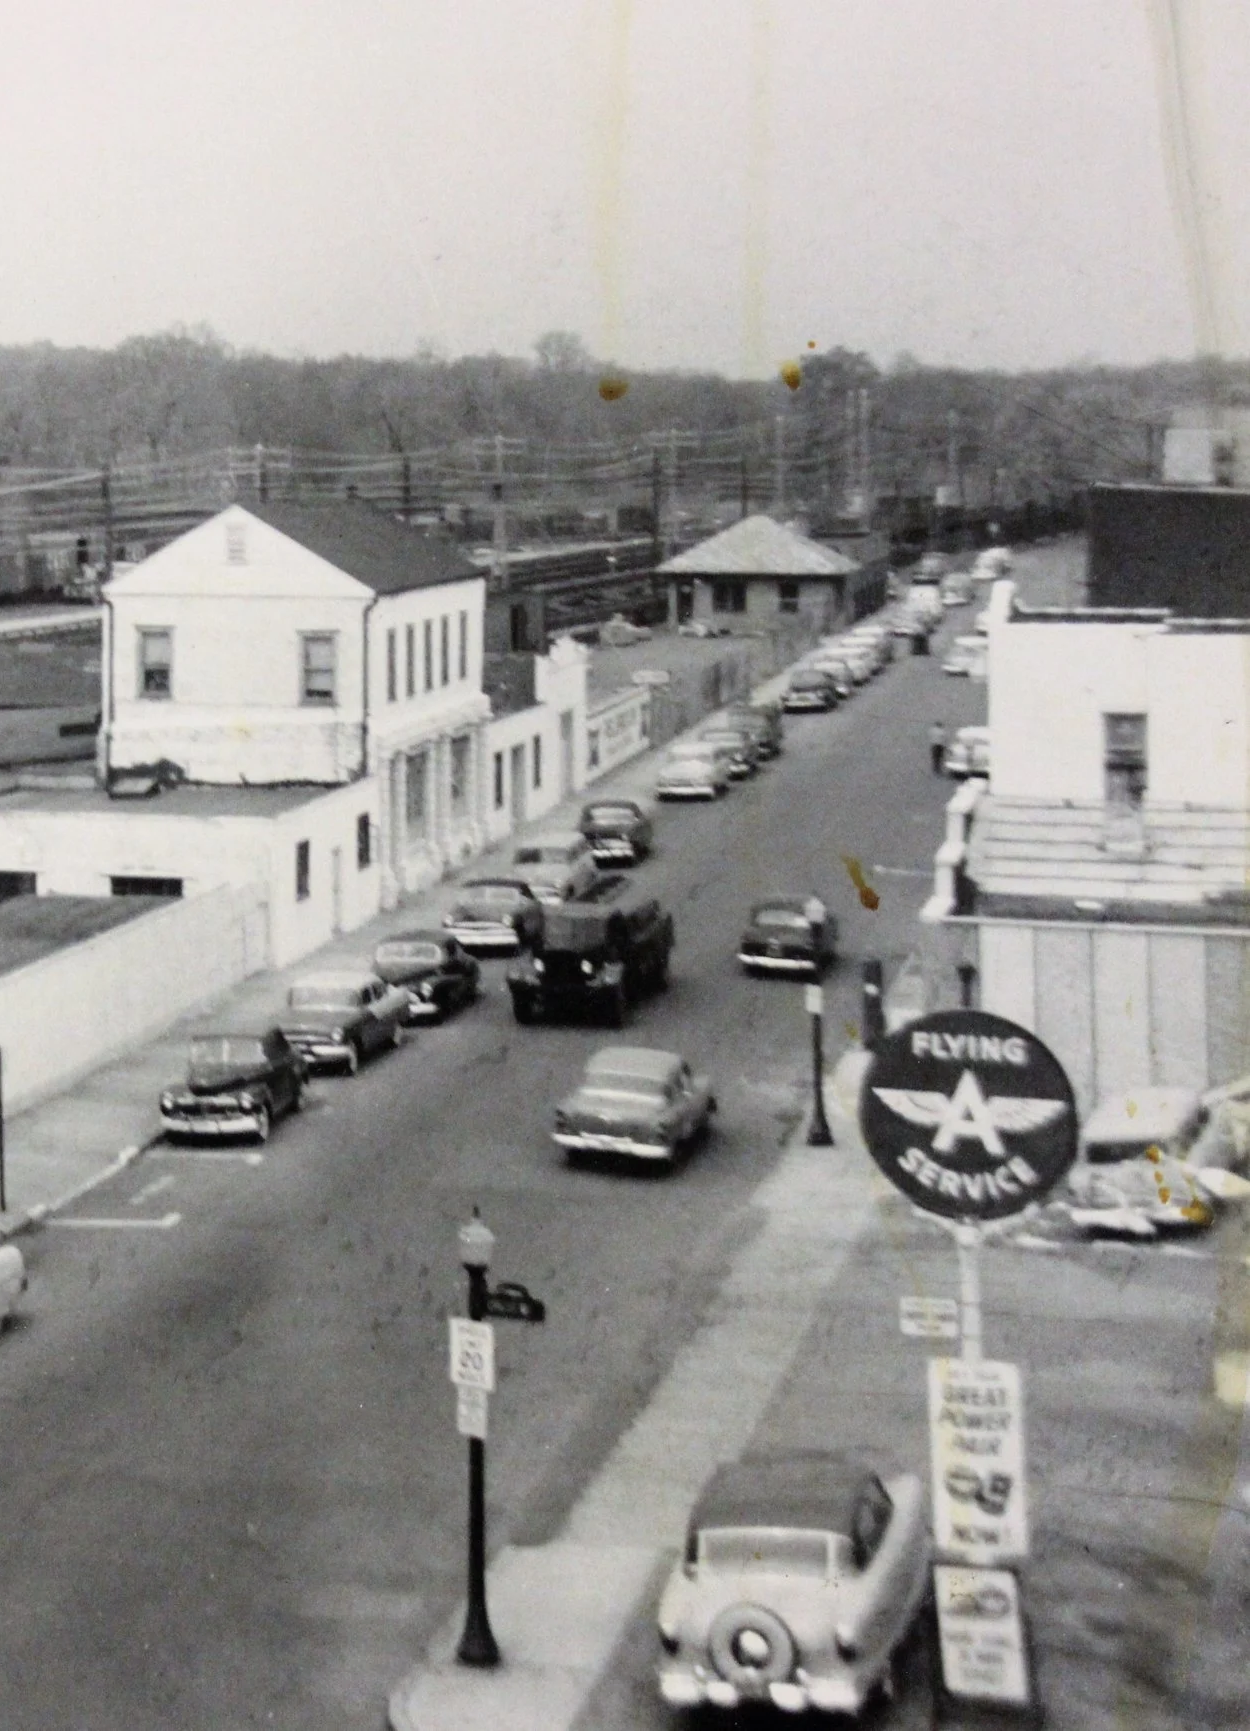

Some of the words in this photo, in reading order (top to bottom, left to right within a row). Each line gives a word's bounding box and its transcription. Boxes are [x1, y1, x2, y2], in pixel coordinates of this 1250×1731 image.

[911, 1031, 1030, 1065] FLYING
[897, 1147, 1041, 1201] SERVICE
[942, 1384, 1007, 1407] GREAT
[939, 1405, 1012, 1431] POWER
